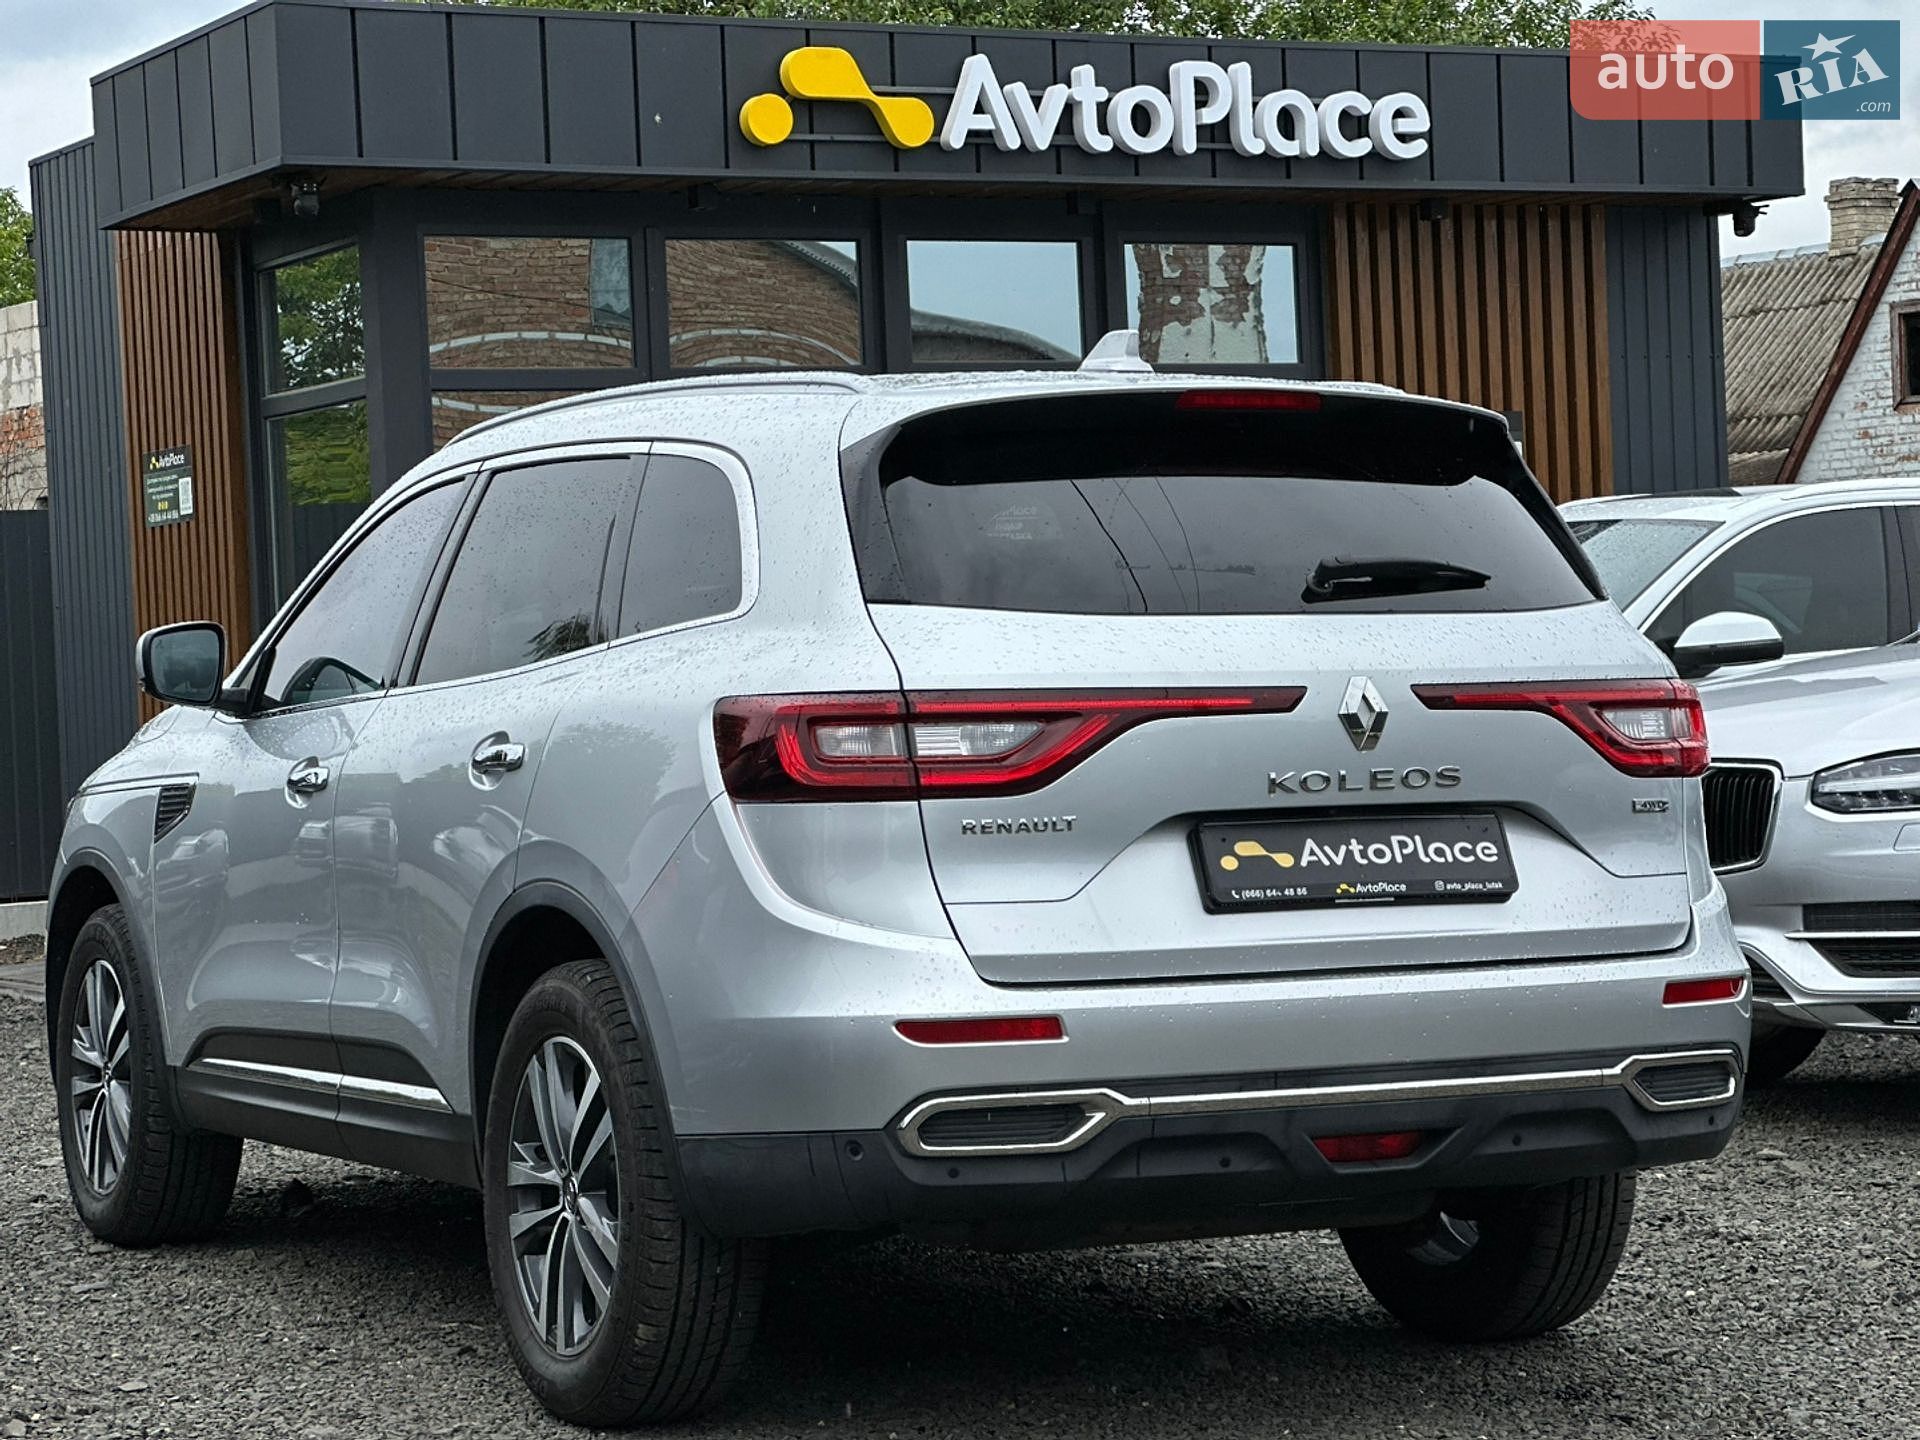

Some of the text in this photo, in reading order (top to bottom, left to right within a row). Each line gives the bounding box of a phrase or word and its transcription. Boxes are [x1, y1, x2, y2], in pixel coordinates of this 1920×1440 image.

[940, 53, 1430, 160] AvtoPlace
[1268, 765, 1462, 795] KOLEOS
[961, 815, 1077, 835] RENAULT
[1300, 835, 1498, 867] AvtoPlace
[1356, 882, 1406, 893] AvtoPlace
